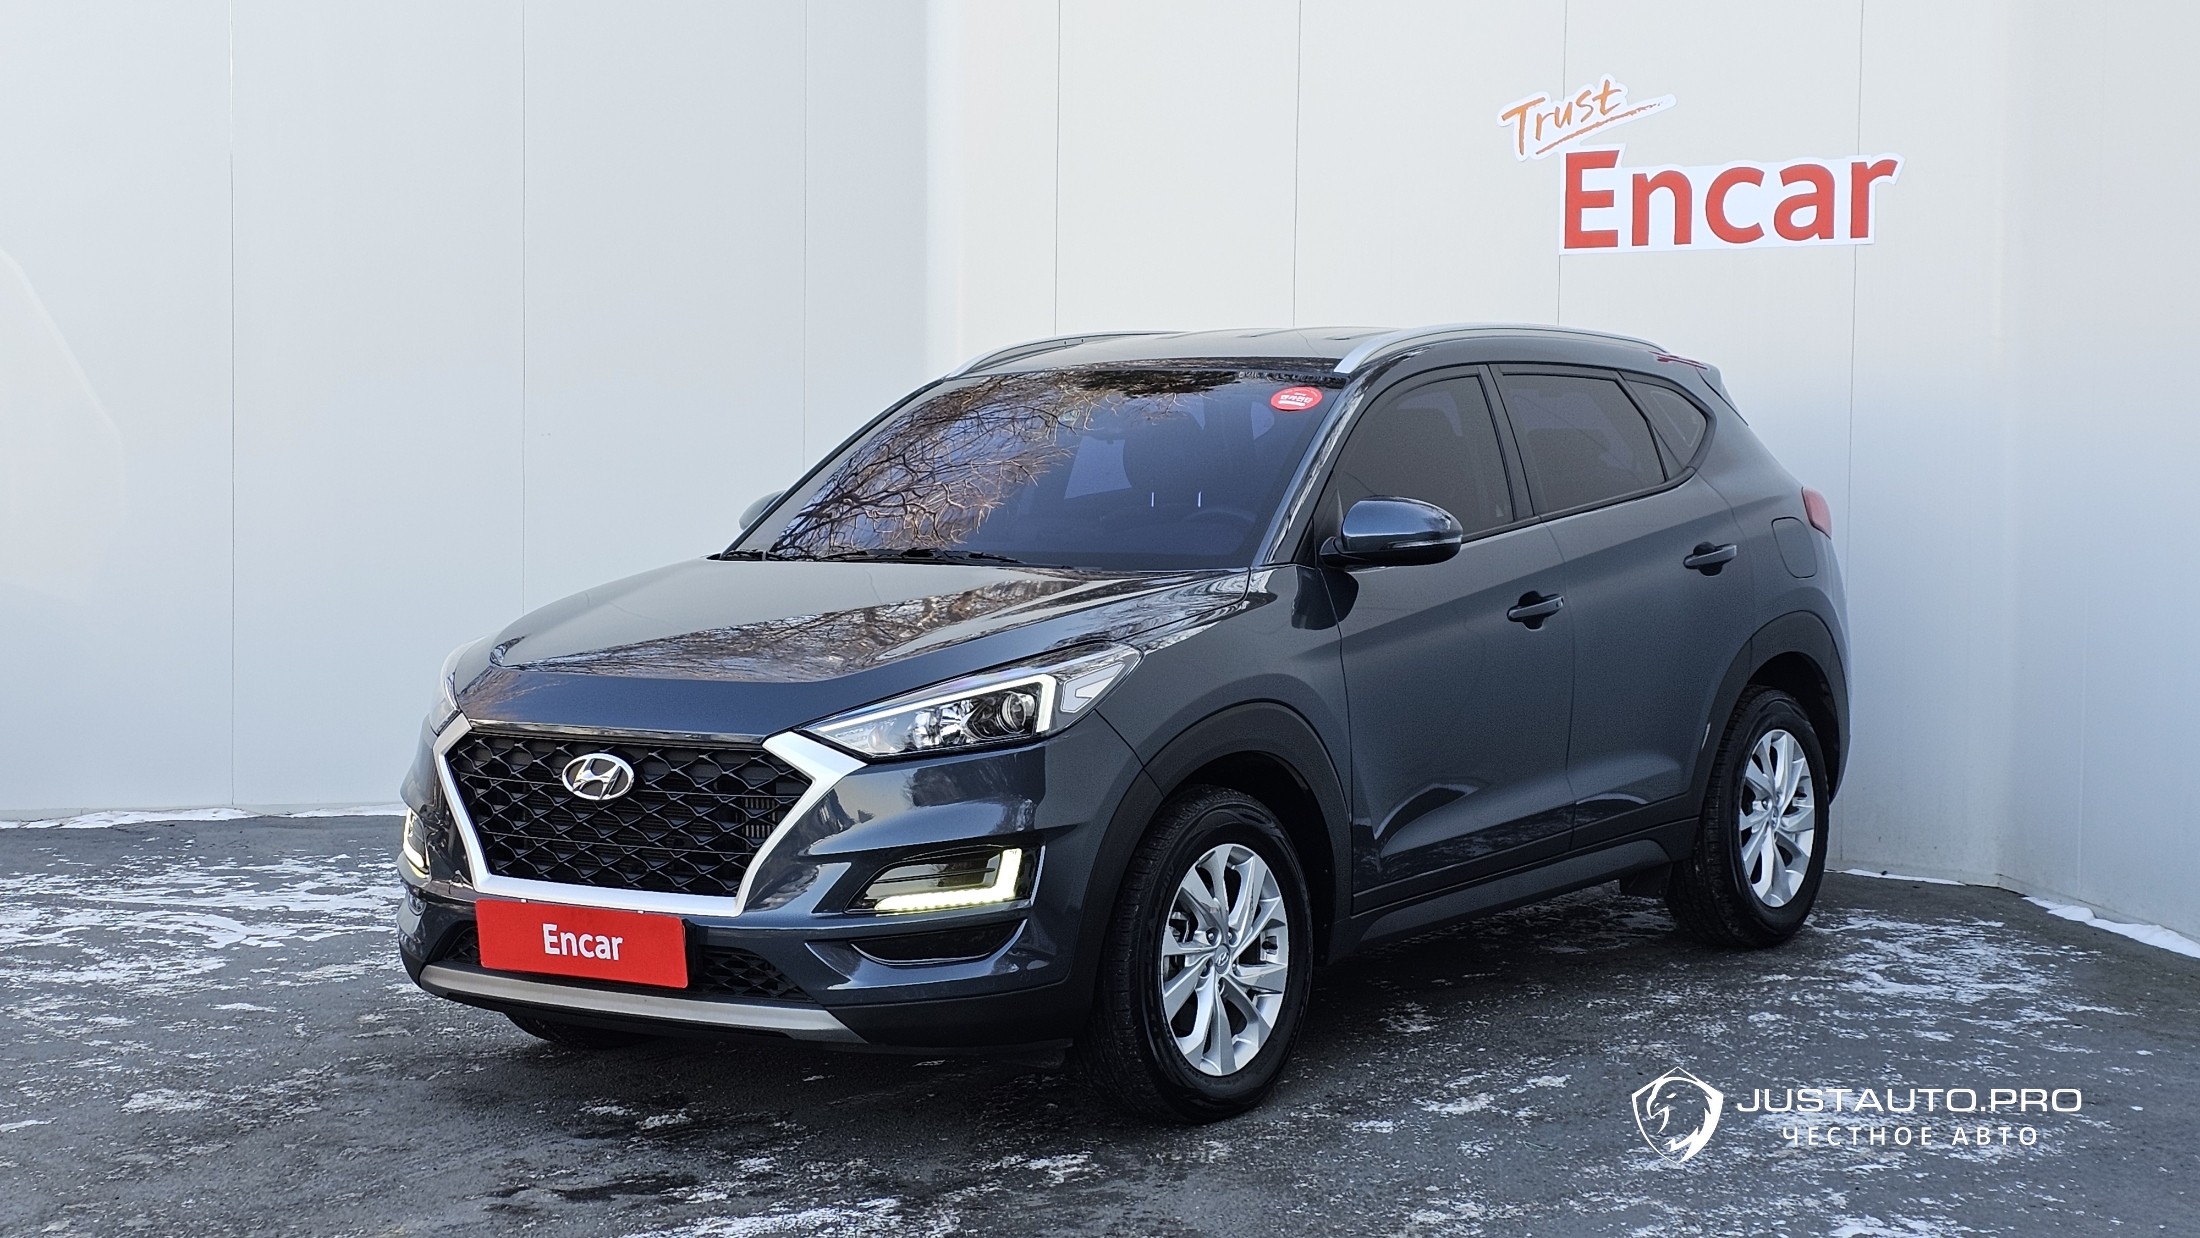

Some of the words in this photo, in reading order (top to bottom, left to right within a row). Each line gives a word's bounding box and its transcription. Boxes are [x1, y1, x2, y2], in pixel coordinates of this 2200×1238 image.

[1501, 79, 1622, 155] Trust
[1564, 149, 1898, 249] Encar
[542, 922, 624, 961] Encar
